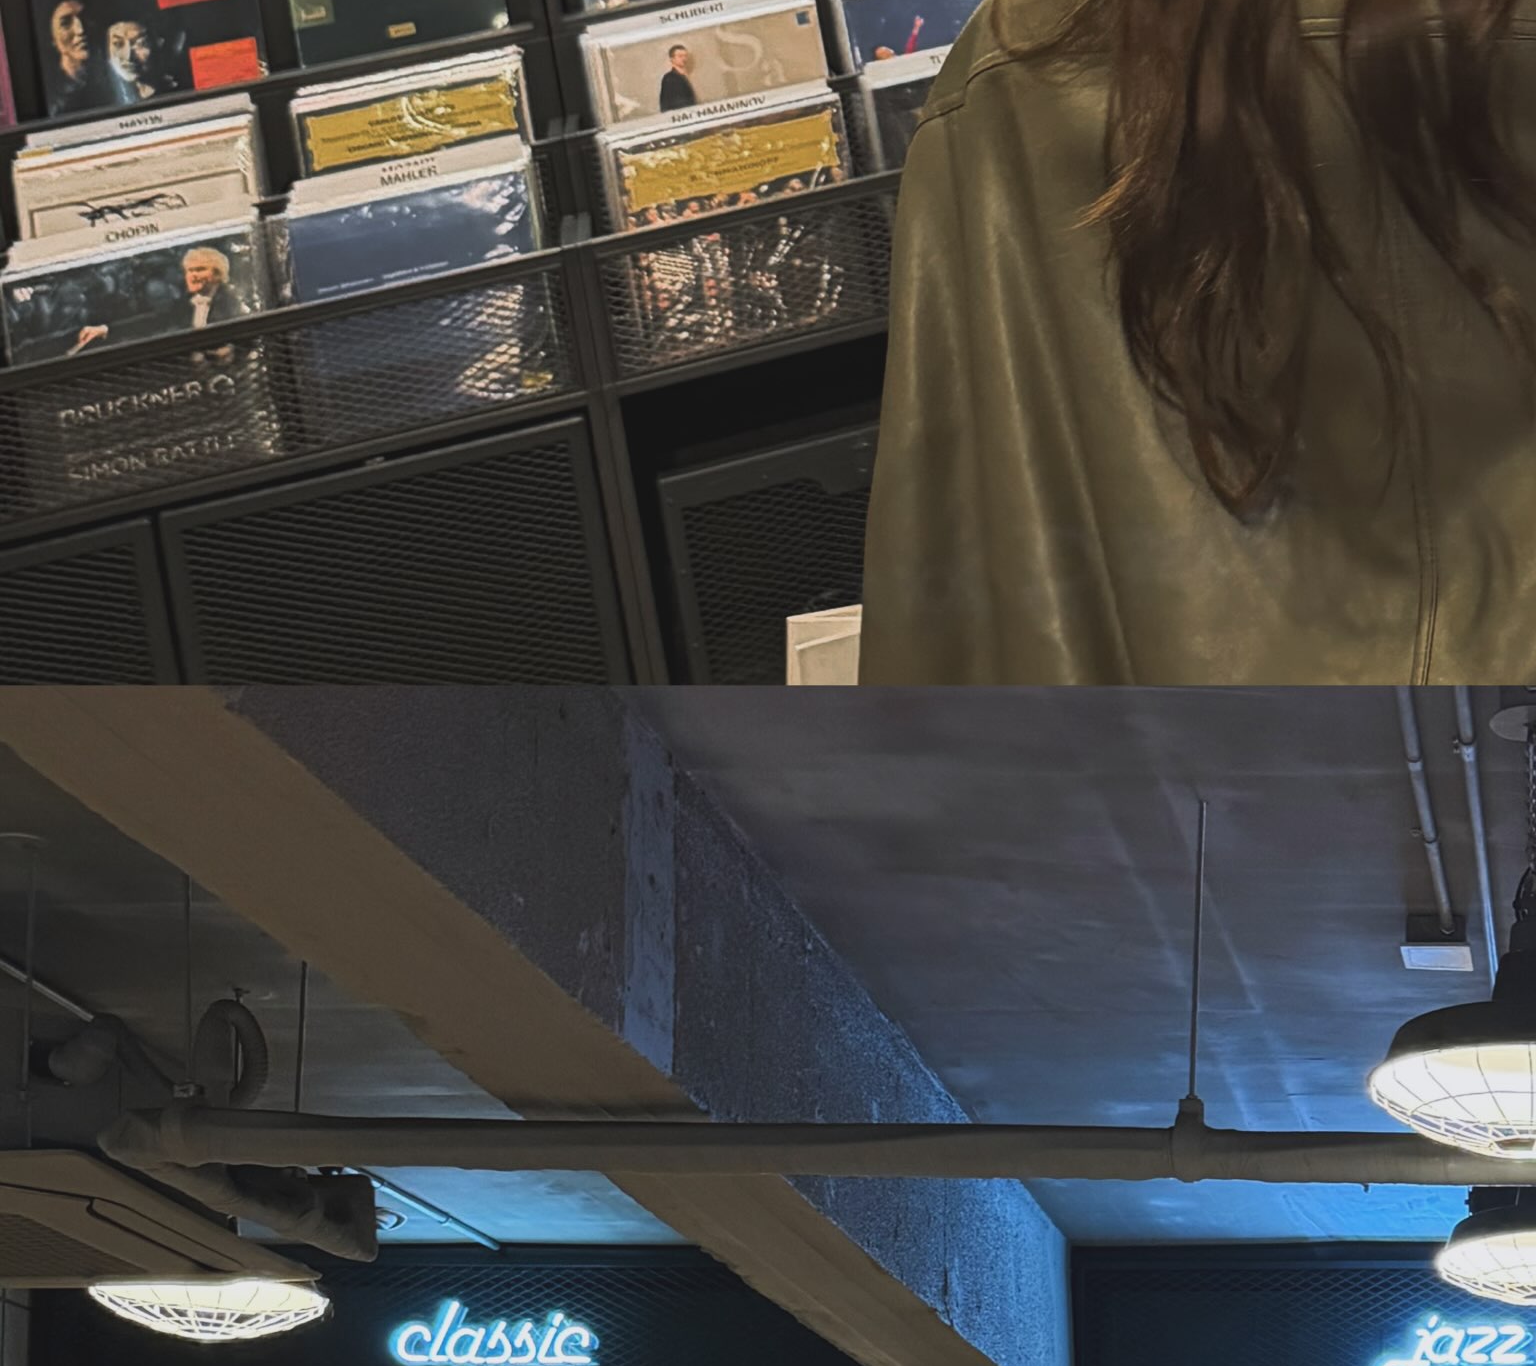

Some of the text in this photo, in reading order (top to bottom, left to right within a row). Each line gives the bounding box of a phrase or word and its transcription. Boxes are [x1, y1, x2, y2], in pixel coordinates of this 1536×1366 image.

[659, 1, 725, 25] SCHUBERT
[670, 94, 766, 125] RACHMANINOV
[379, 165, 438, 187] MAHLER
[105, 223, 160, 243] CHOPIN
[394, 1299, 597, 1366] classic
